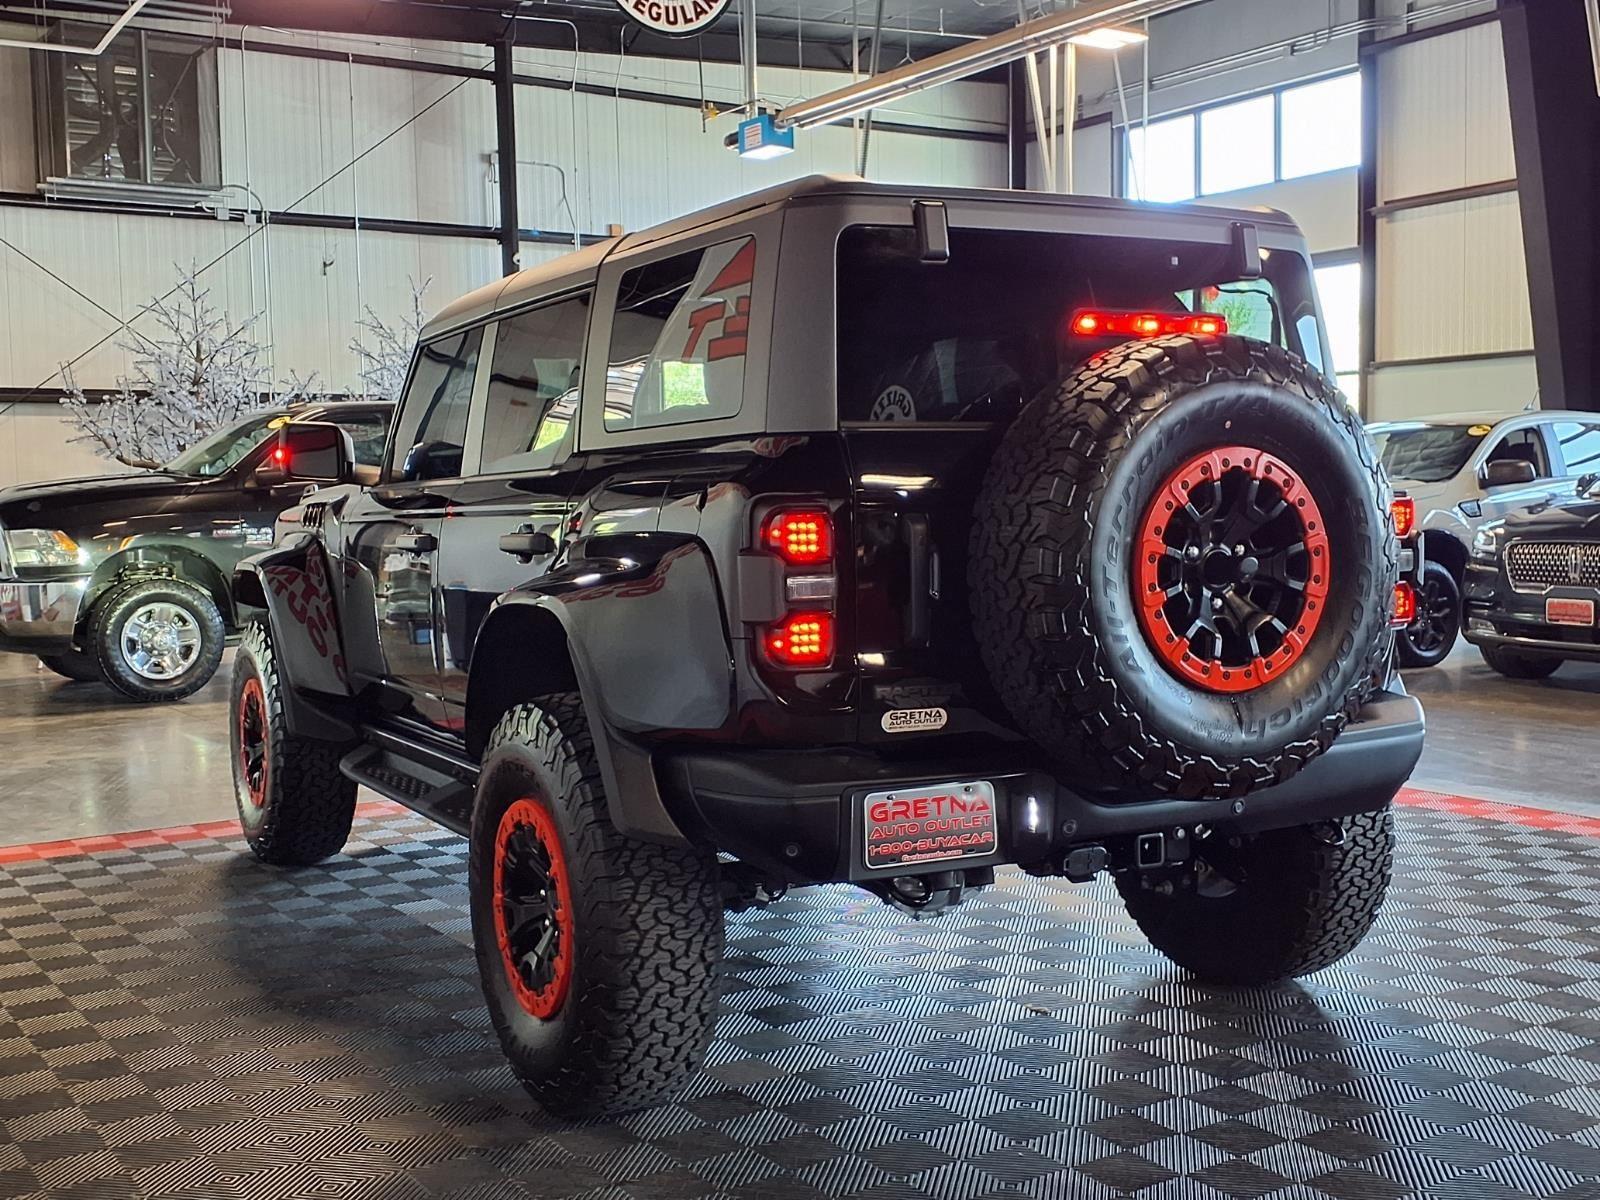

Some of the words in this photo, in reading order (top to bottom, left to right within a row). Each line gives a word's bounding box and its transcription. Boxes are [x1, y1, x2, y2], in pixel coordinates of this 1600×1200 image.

[889, 710, 942, 720] GRETNA
[913, 717, 943, 725] OUTLET
[870, 796, 990, 823] GRETNA
[869, 823, 919, 840] AUTO
[925, 814, 992, 832] OUTLET
[868, 832, 993, 856] 1-800-BUYACAR
